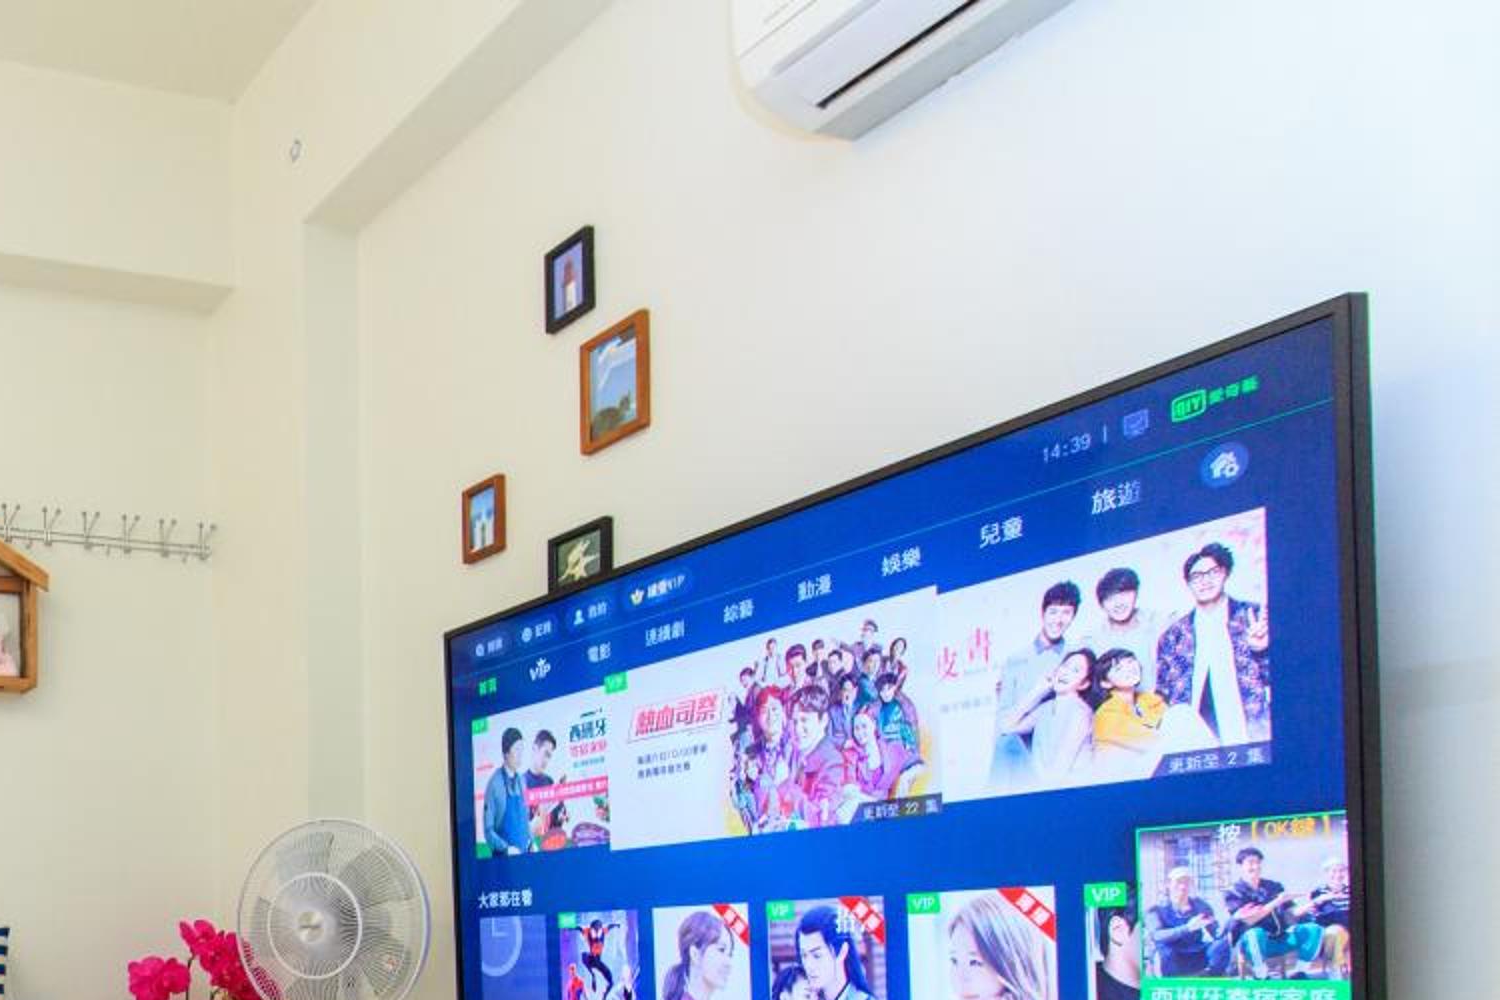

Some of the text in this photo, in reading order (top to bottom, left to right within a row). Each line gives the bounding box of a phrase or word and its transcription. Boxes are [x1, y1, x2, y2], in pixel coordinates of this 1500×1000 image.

[1043, 432, 1092, 463] 14:39
[1092, 480, 1140, 514] 旅遊
[979, 515, 1023, 549] 兒童
[882, 546, 921, 577] 娛樂
[797, 574, 832, 602] 動漫
[723, 599, 754, 624] 綜藝
[645, 620, 685, 647] 連續劇
[529, 659, 551, 681] VIP
[1227, 751, 1238, 766] 2
[478, 888, 532, 909] 大家都在看
[911, 895, 935, 911] VIP
[1090, 886, 1121, 903] VIP
[770, 904, 790, 918] VIP
